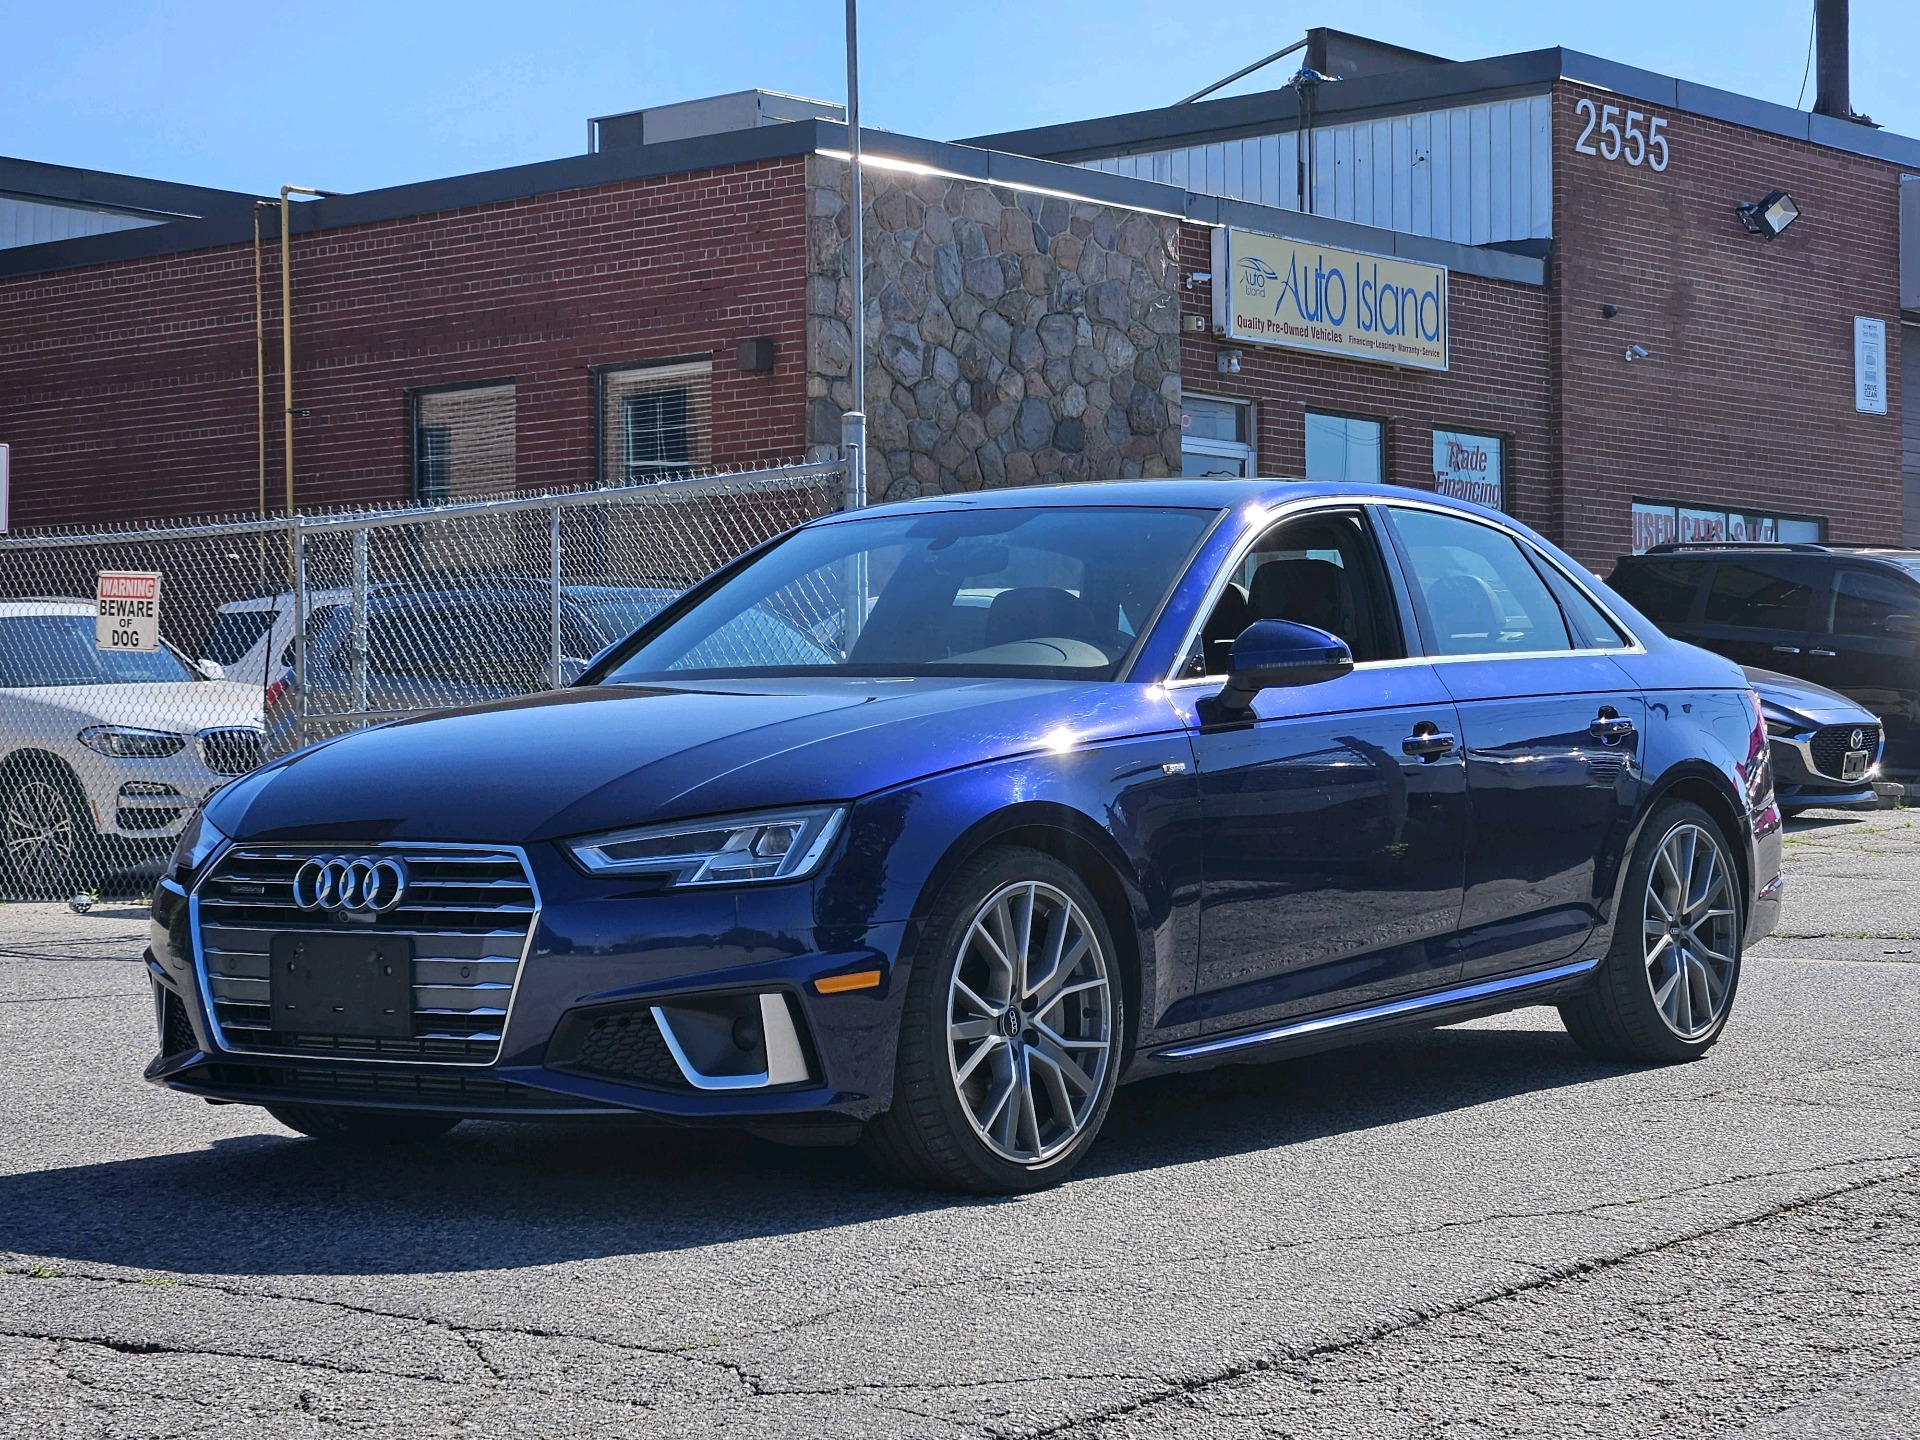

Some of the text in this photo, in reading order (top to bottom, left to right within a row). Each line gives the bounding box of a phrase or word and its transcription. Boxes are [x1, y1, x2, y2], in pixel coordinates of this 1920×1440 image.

[1575, 98, 1669, 172] 2555
[1240, 270, 1265, 288] Auto
[1245, 284, 1266, 298] Island
[1274, 249, 1440, 342] Auto Island
[1237, 314, 1343, 343] Quality Pre-Owned Vehicles
[1447, 441, 1488, 472] Trade
[1435, 470, 1501, 509] Financing
[102, 579, 154, 597] WARNING
[100, 599, 153, 618] BEWARE
[119, 618, 133, 628] OF
[112, 629, 139, 647] DOG
